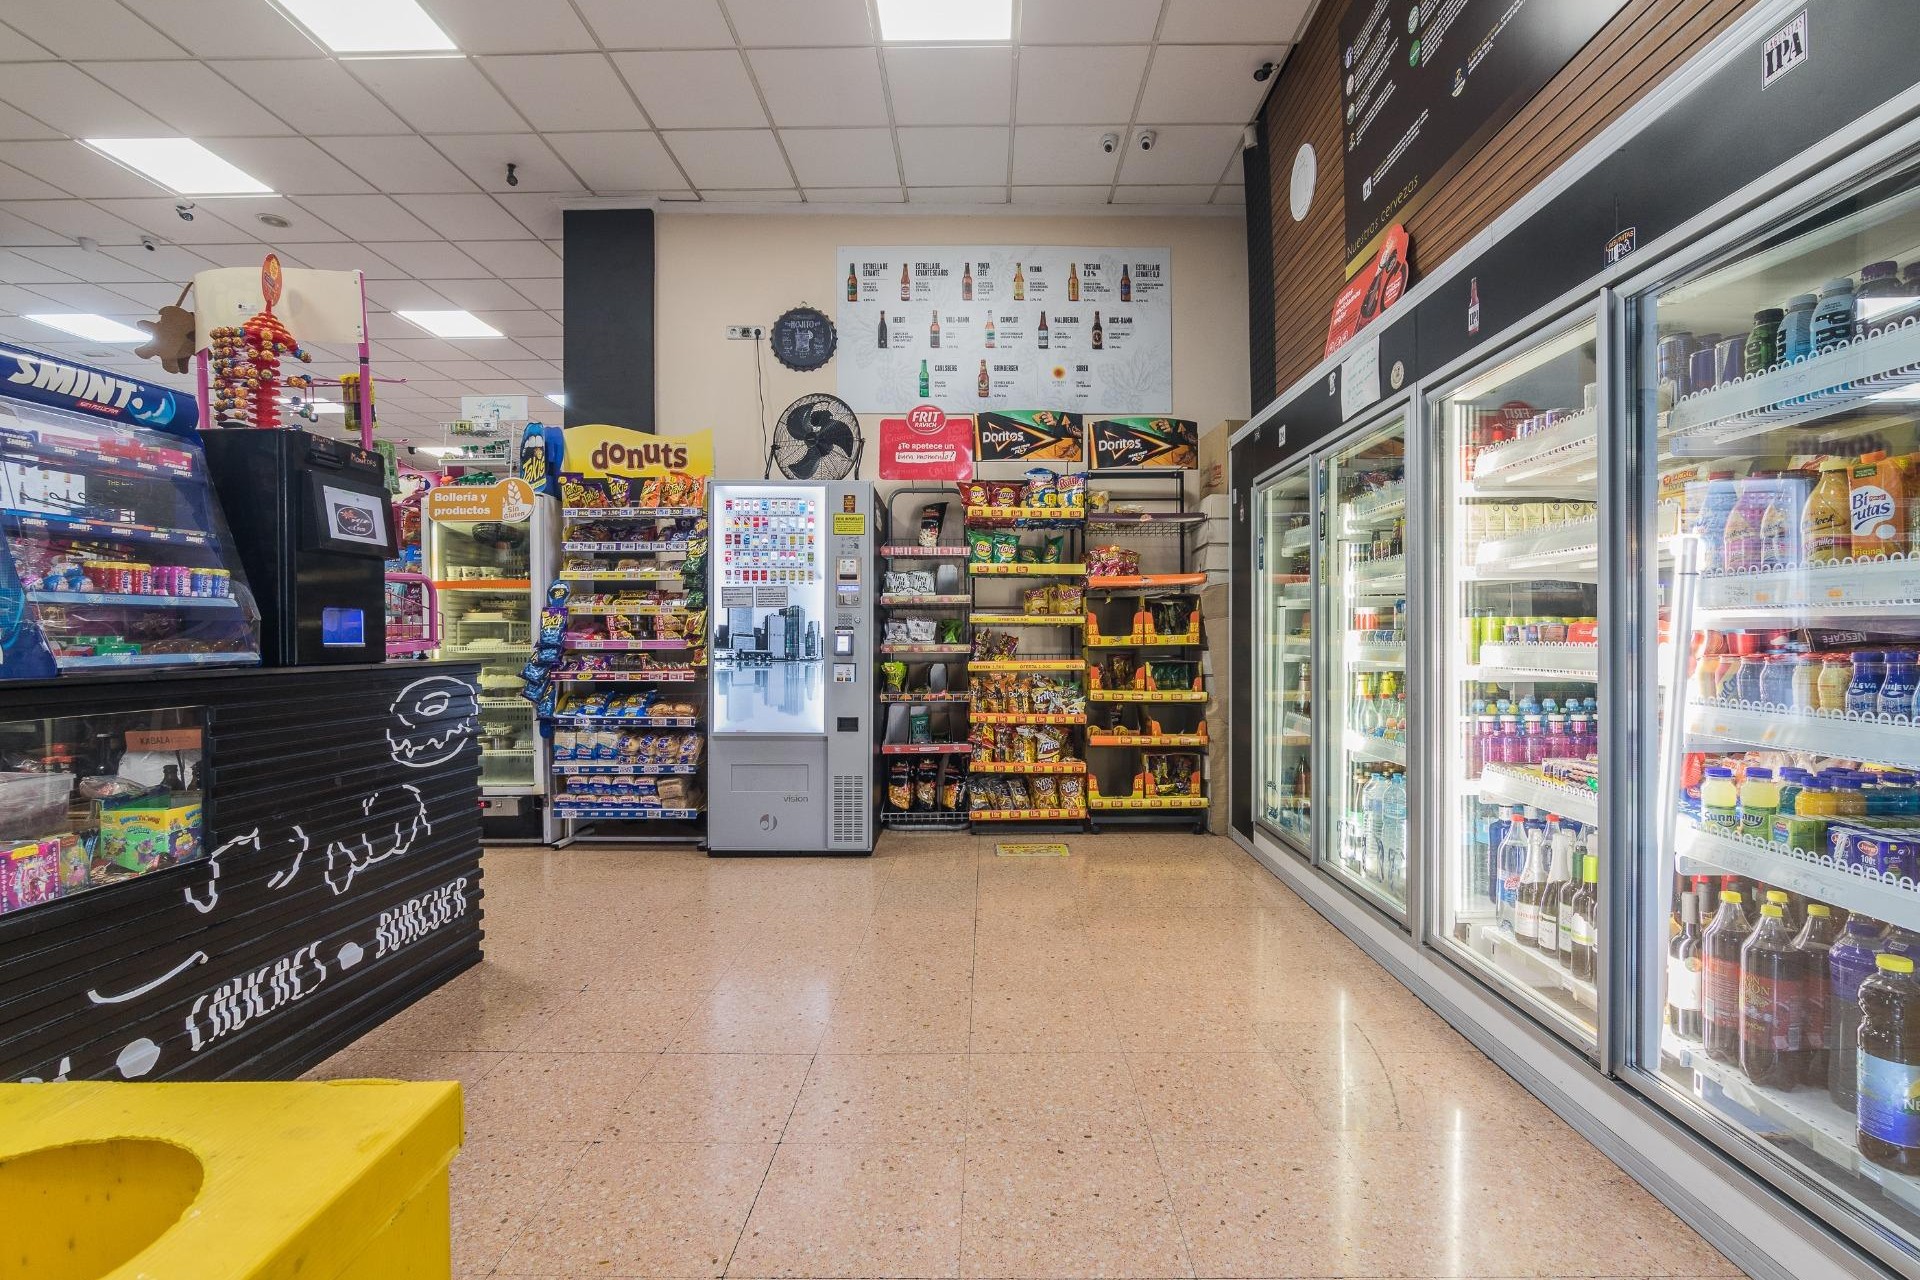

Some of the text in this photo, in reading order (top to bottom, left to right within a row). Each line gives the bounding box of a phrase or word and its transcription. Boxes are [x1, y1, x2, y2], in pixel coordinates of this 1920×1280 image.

[1766, 31, 1803, 78] IPA
[1347, 217, 1379, 258] Nuestras
[1380, 175, 1419, 222] cervezas
[8, 353, 138, 409] SMINT
[912, 411, 941, 422] FRIT
[982, 431, 1025, 443] Doritos
[6, 438, 32, 448] SMINT
[1098, 439, 1142, 451] Doritos
[54, 446, 77, 455] SMINT
[591, 442, 688, 469] donuts
[97, 454, 119, 463] SMINT
[137, 462, 157, 471] SMINT
[522, 456, 545, 483] Takis
[173, 469, 192, 477] SMINT
[609, 481, 628, 494] Takis
[434, 491, 487, 502] Bollería y
[434, 505, 490, 517] productos
[507, 505, 520, 513] Sin
[1851, 501, 1891, 523] rutas
[503, 511, 525, 519] Gluten
[22, 517, 48, 526] SMINT
[68, 522, 92, 531] SMINT
[111, 528, 133, 536] SMINT
[150, 532, 170, 540] SMINT
[542, 614, 564, 629] Takis
[139, 736, 170, 745] KABALA
[784, 794, 809, 803] vision
[1704, 811, 1735, 827] Sunny
[375, 877, 467, 959] BURGUER
